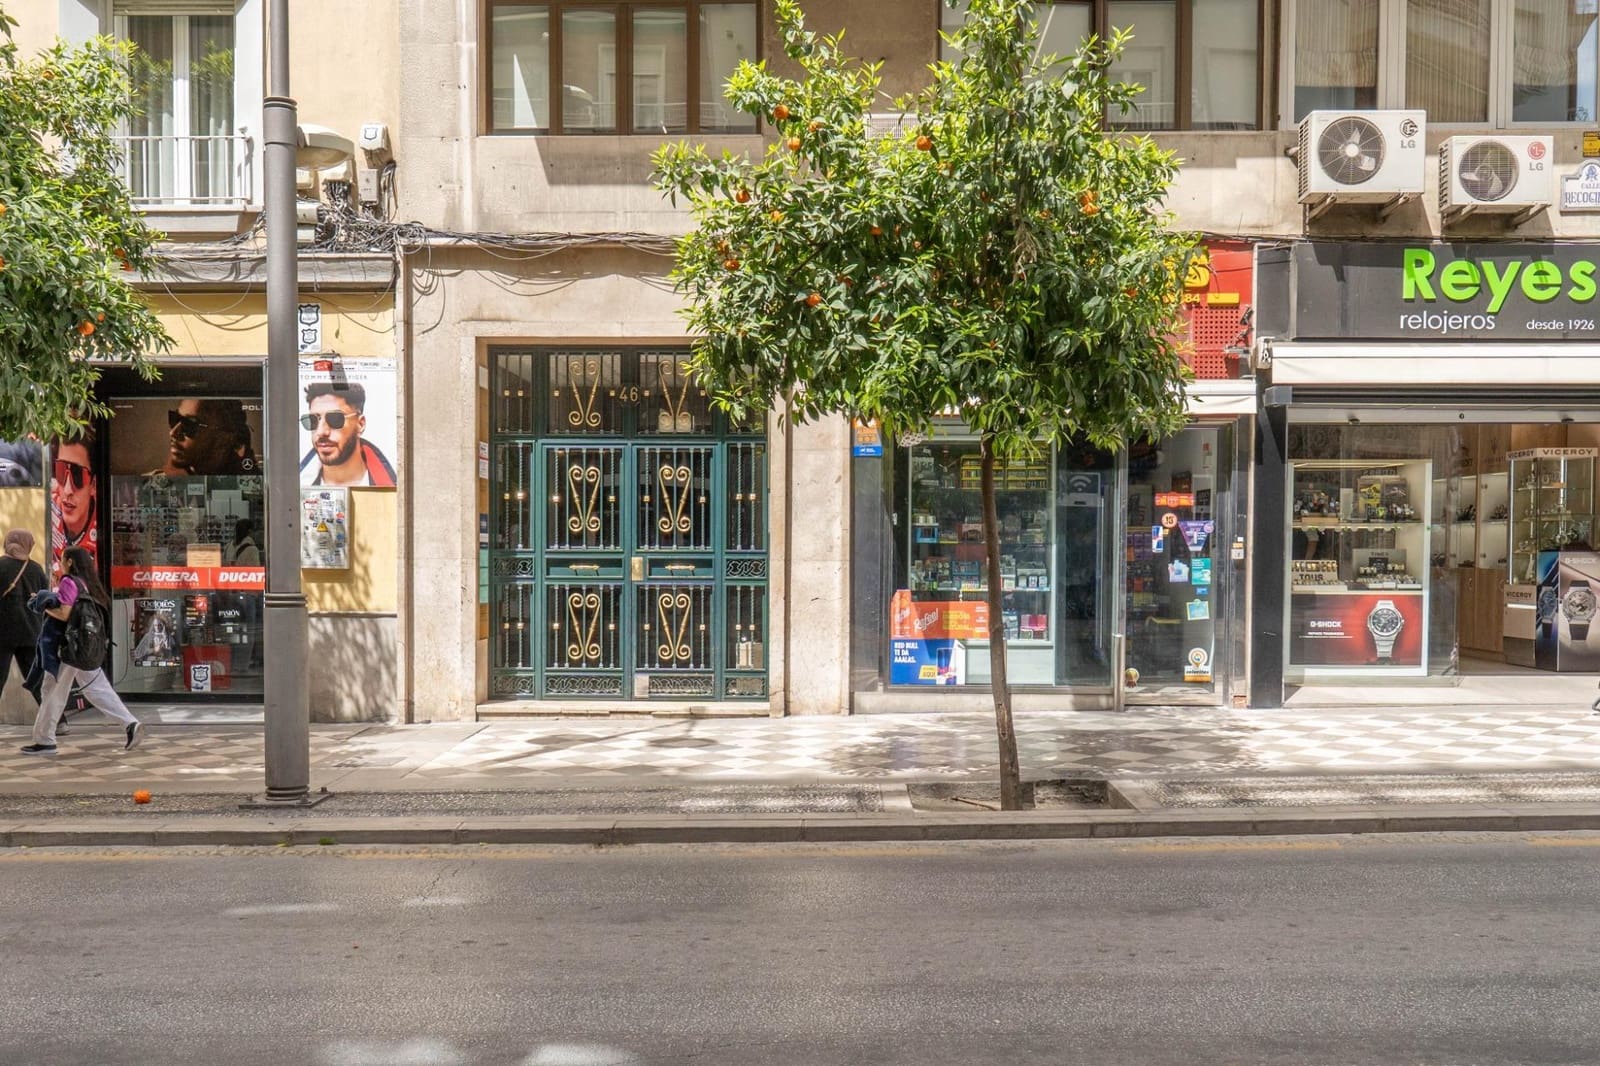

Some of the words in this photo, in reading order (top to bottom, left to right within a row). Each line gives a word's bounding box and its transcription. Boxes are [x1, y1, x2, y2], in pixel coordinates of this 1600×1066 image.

[1400, 140, 1416, 149] LG
[1529, 162, 1544, 171] LG
[1402, 248, 1597, 314] Reyes
[1400, 310, 1496, 334] relojeros
[1526, 319, 1565, 330] desde
[1568, 319, 1595, 330] 1926
[619, 386, 638, 402] 46
[1507, 450, 1534, 459] VICEROY
[1542, 448, 1593, 456] VICEROY
[133, 571, 198, 582] CARRERA
